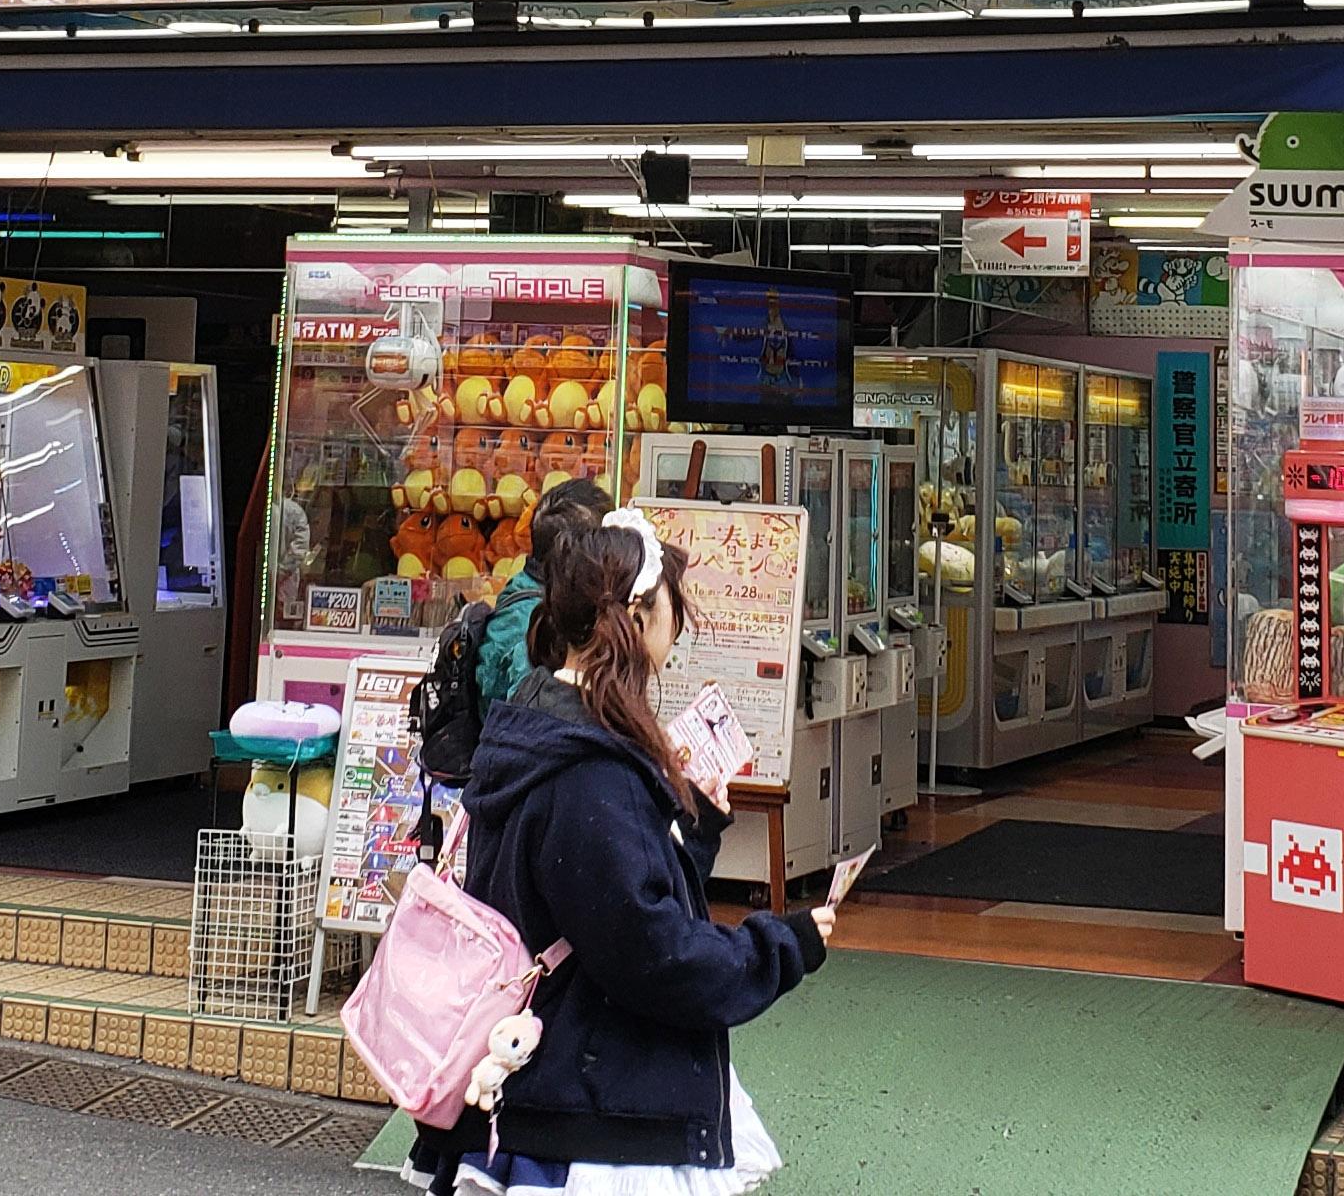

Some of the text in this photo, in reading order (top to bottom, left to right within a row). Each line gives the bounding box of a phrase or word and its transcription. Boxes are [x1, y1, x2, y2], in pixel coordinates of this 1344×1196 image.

[999, 191, 1082, 205] セブン銀行ATM
[1250, 219, 1274, 229] スーモ
[489, 271, 604, 300] TRIPLE
[1172, 370, 1198, 526] 警察官立寄所
[358, 673, 405, 696] Hey
